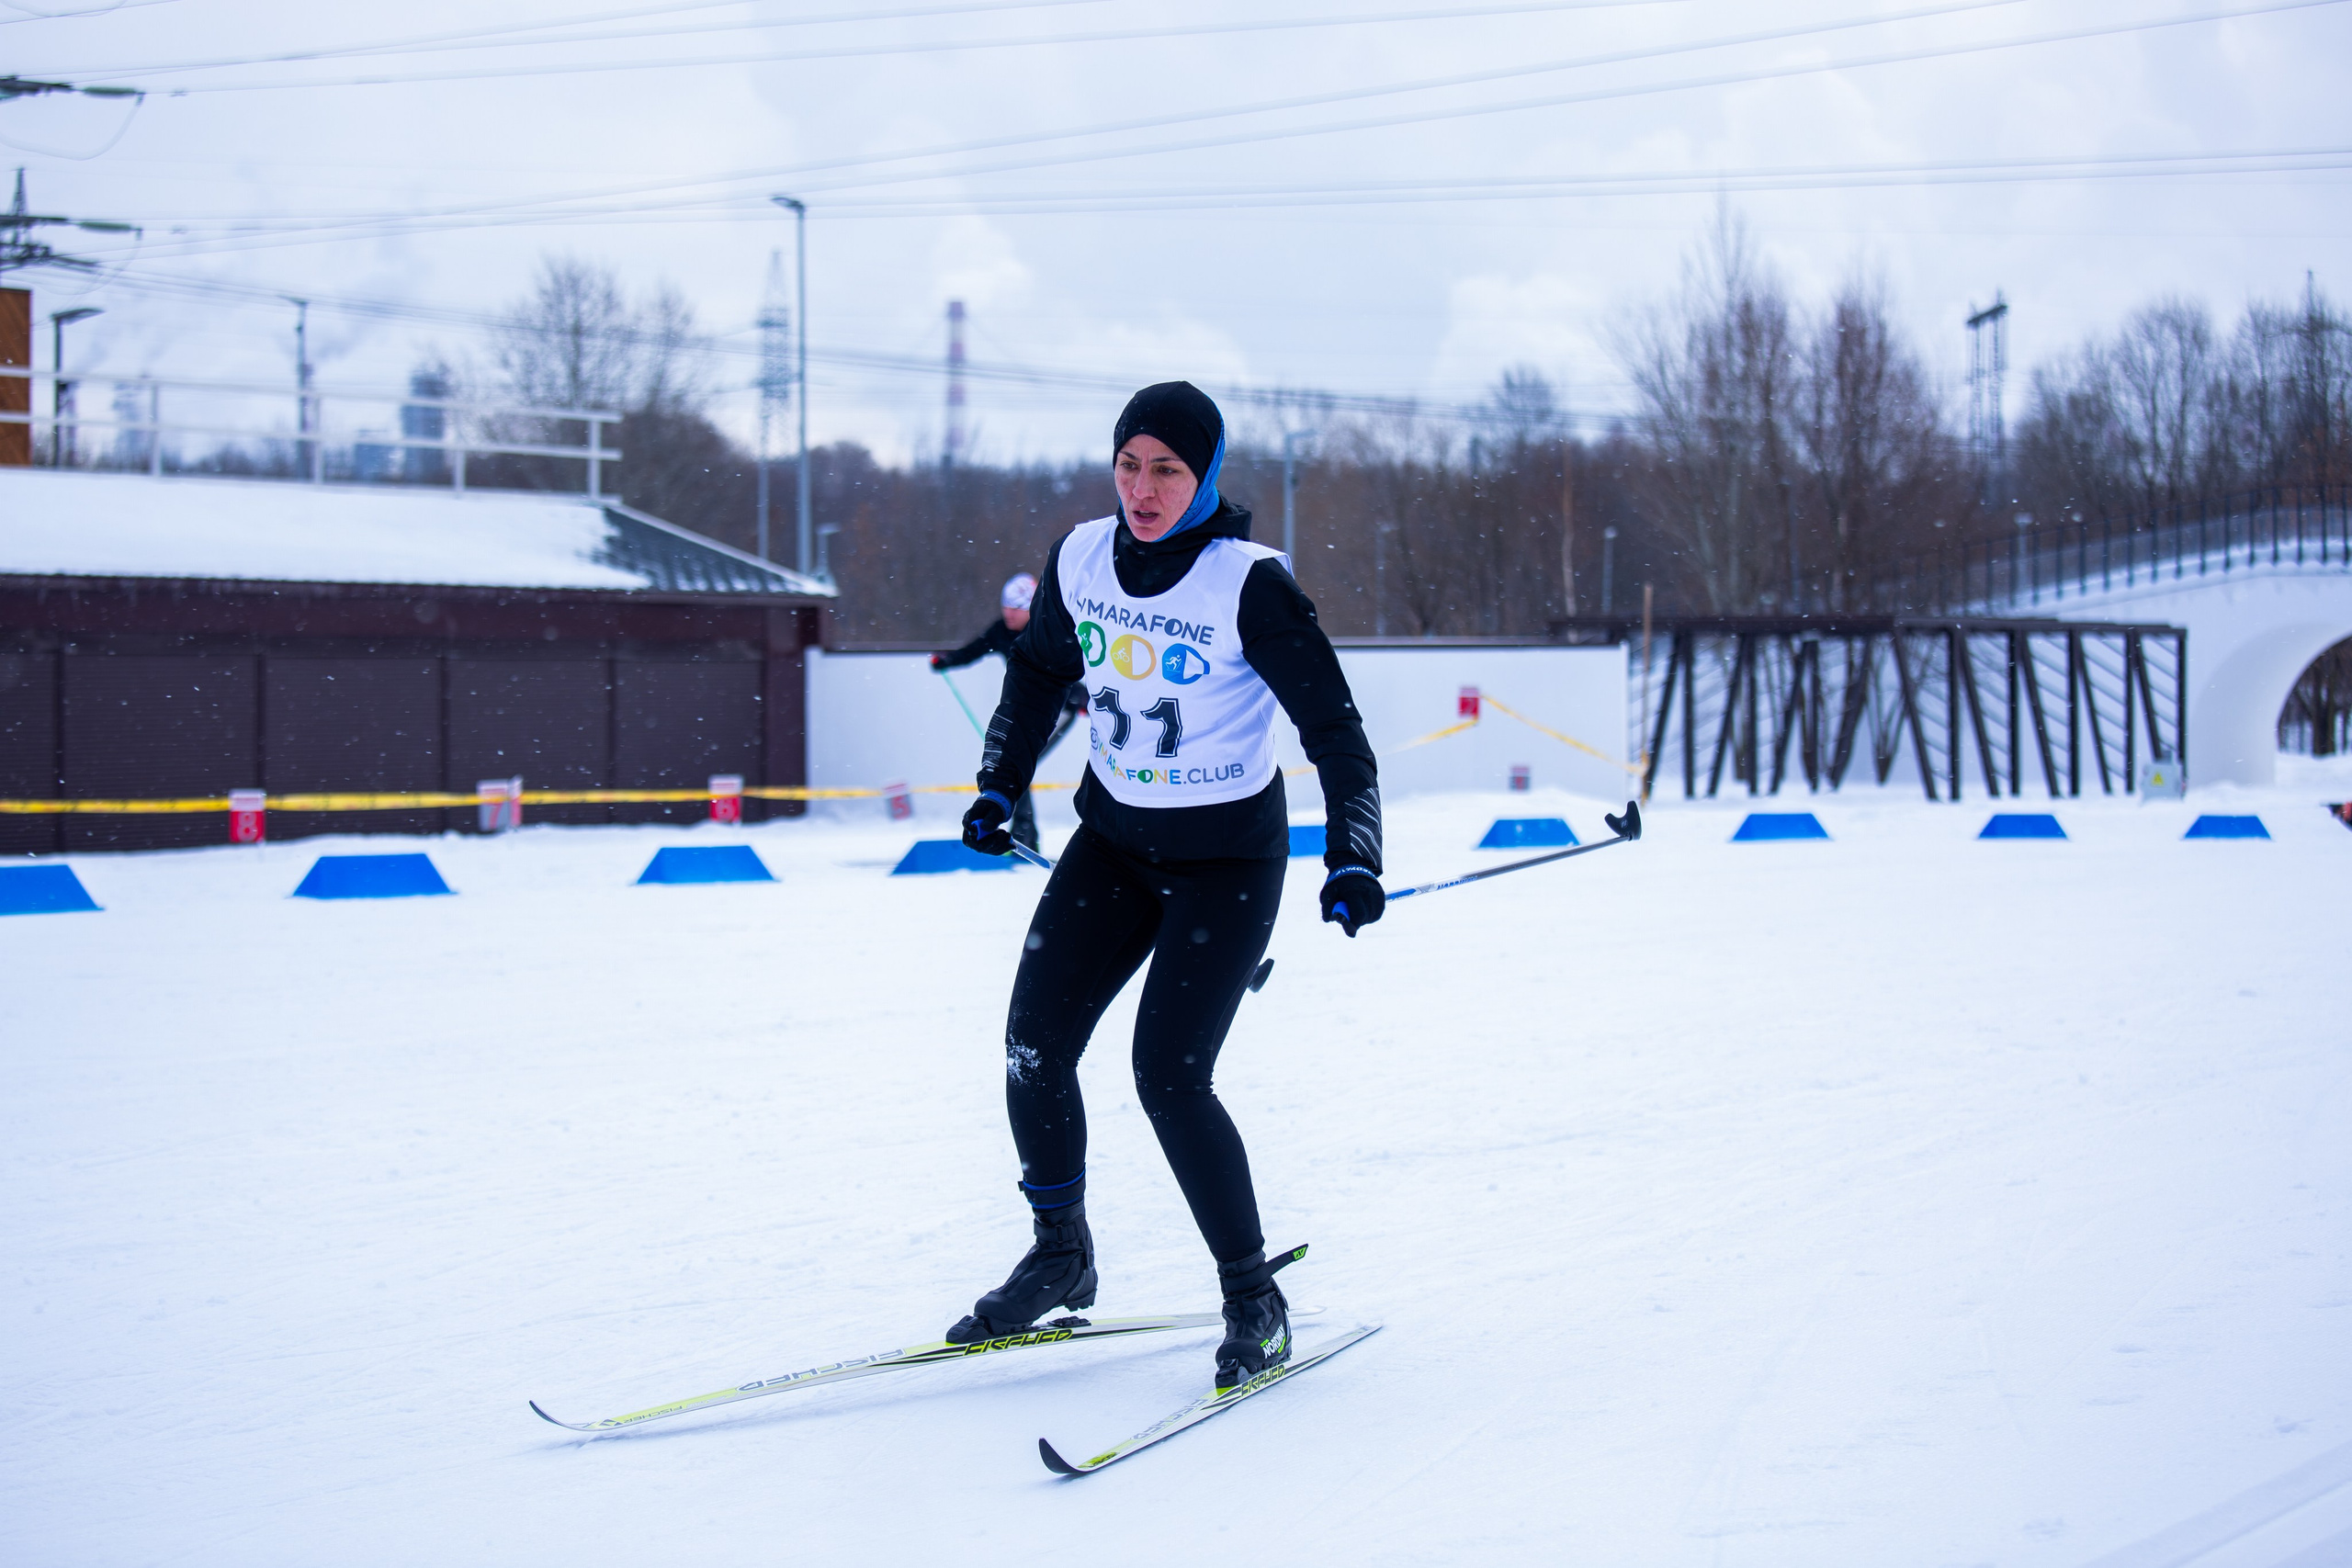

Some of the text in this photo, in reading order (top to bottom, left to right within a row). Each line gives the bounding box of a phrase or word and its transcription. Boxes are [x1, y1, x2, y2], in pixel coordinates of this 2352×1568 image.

[1091, 686, 1183, 758] 11
[890, 795, 911, 820] 5
[237, 812, 257, 842] 8
[624, 1405, 683, 1424] FISCHER
